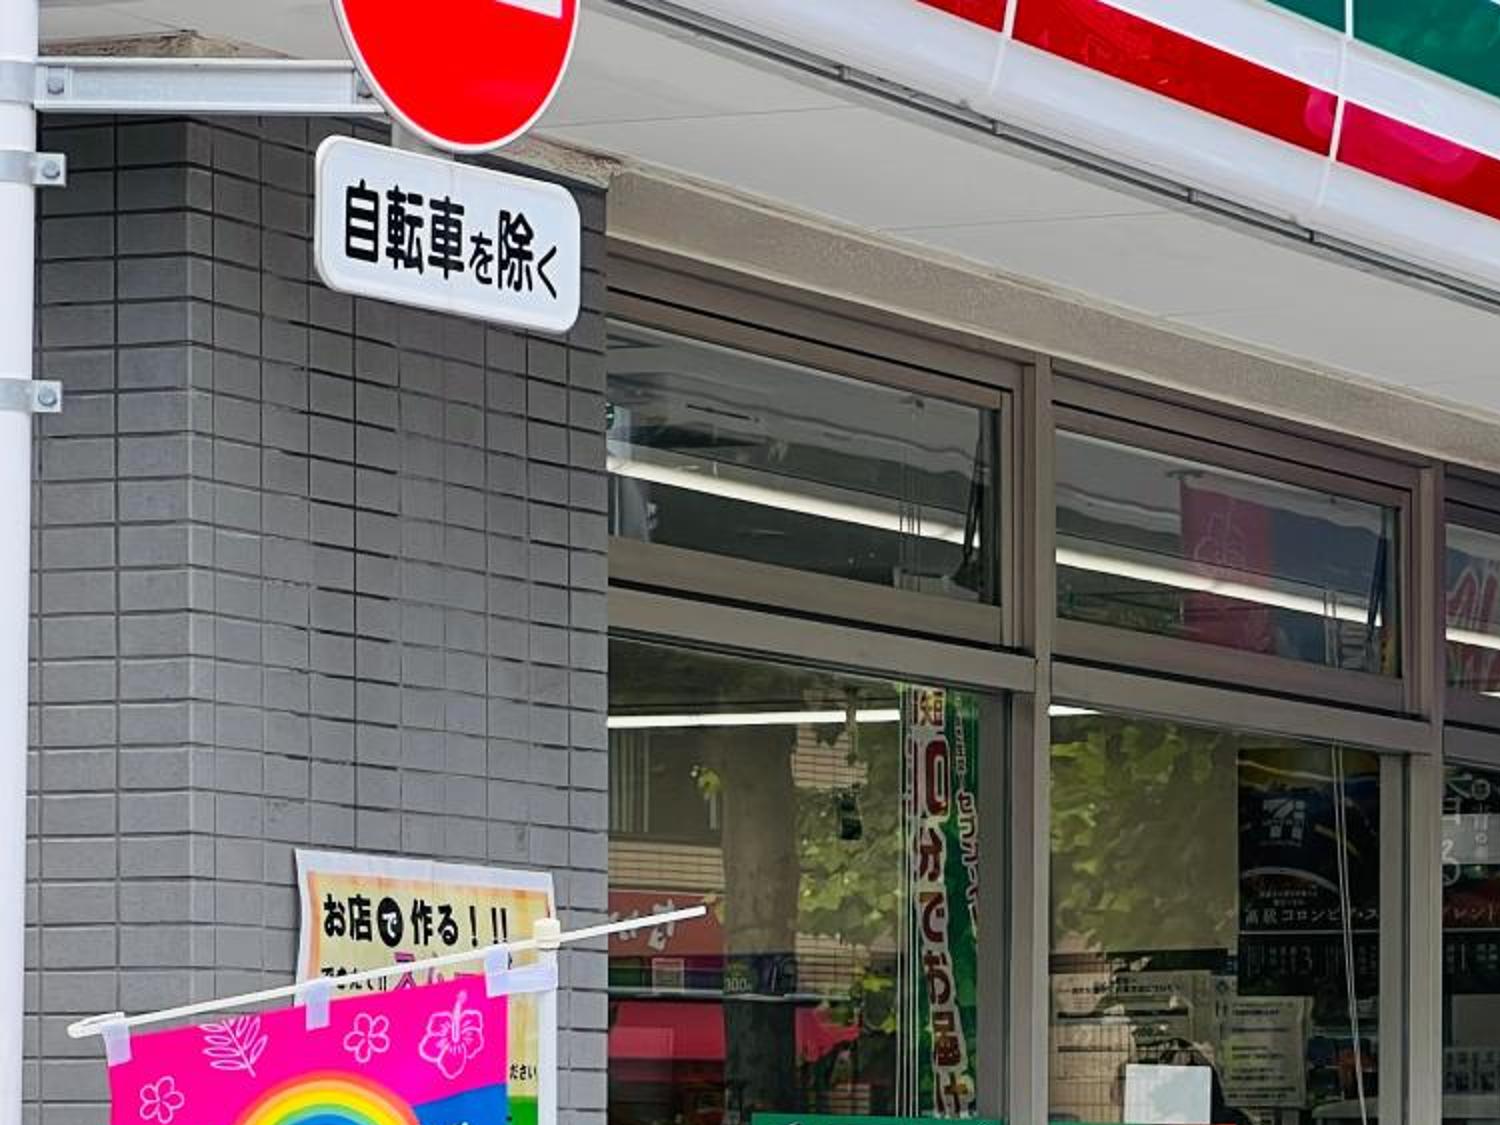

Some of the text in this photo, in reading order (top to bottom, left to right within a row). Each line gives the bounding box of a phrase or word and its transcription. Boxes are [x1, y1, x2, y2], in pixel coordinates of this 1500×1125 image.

[346, 180, 557, 298] 自転車を除く
